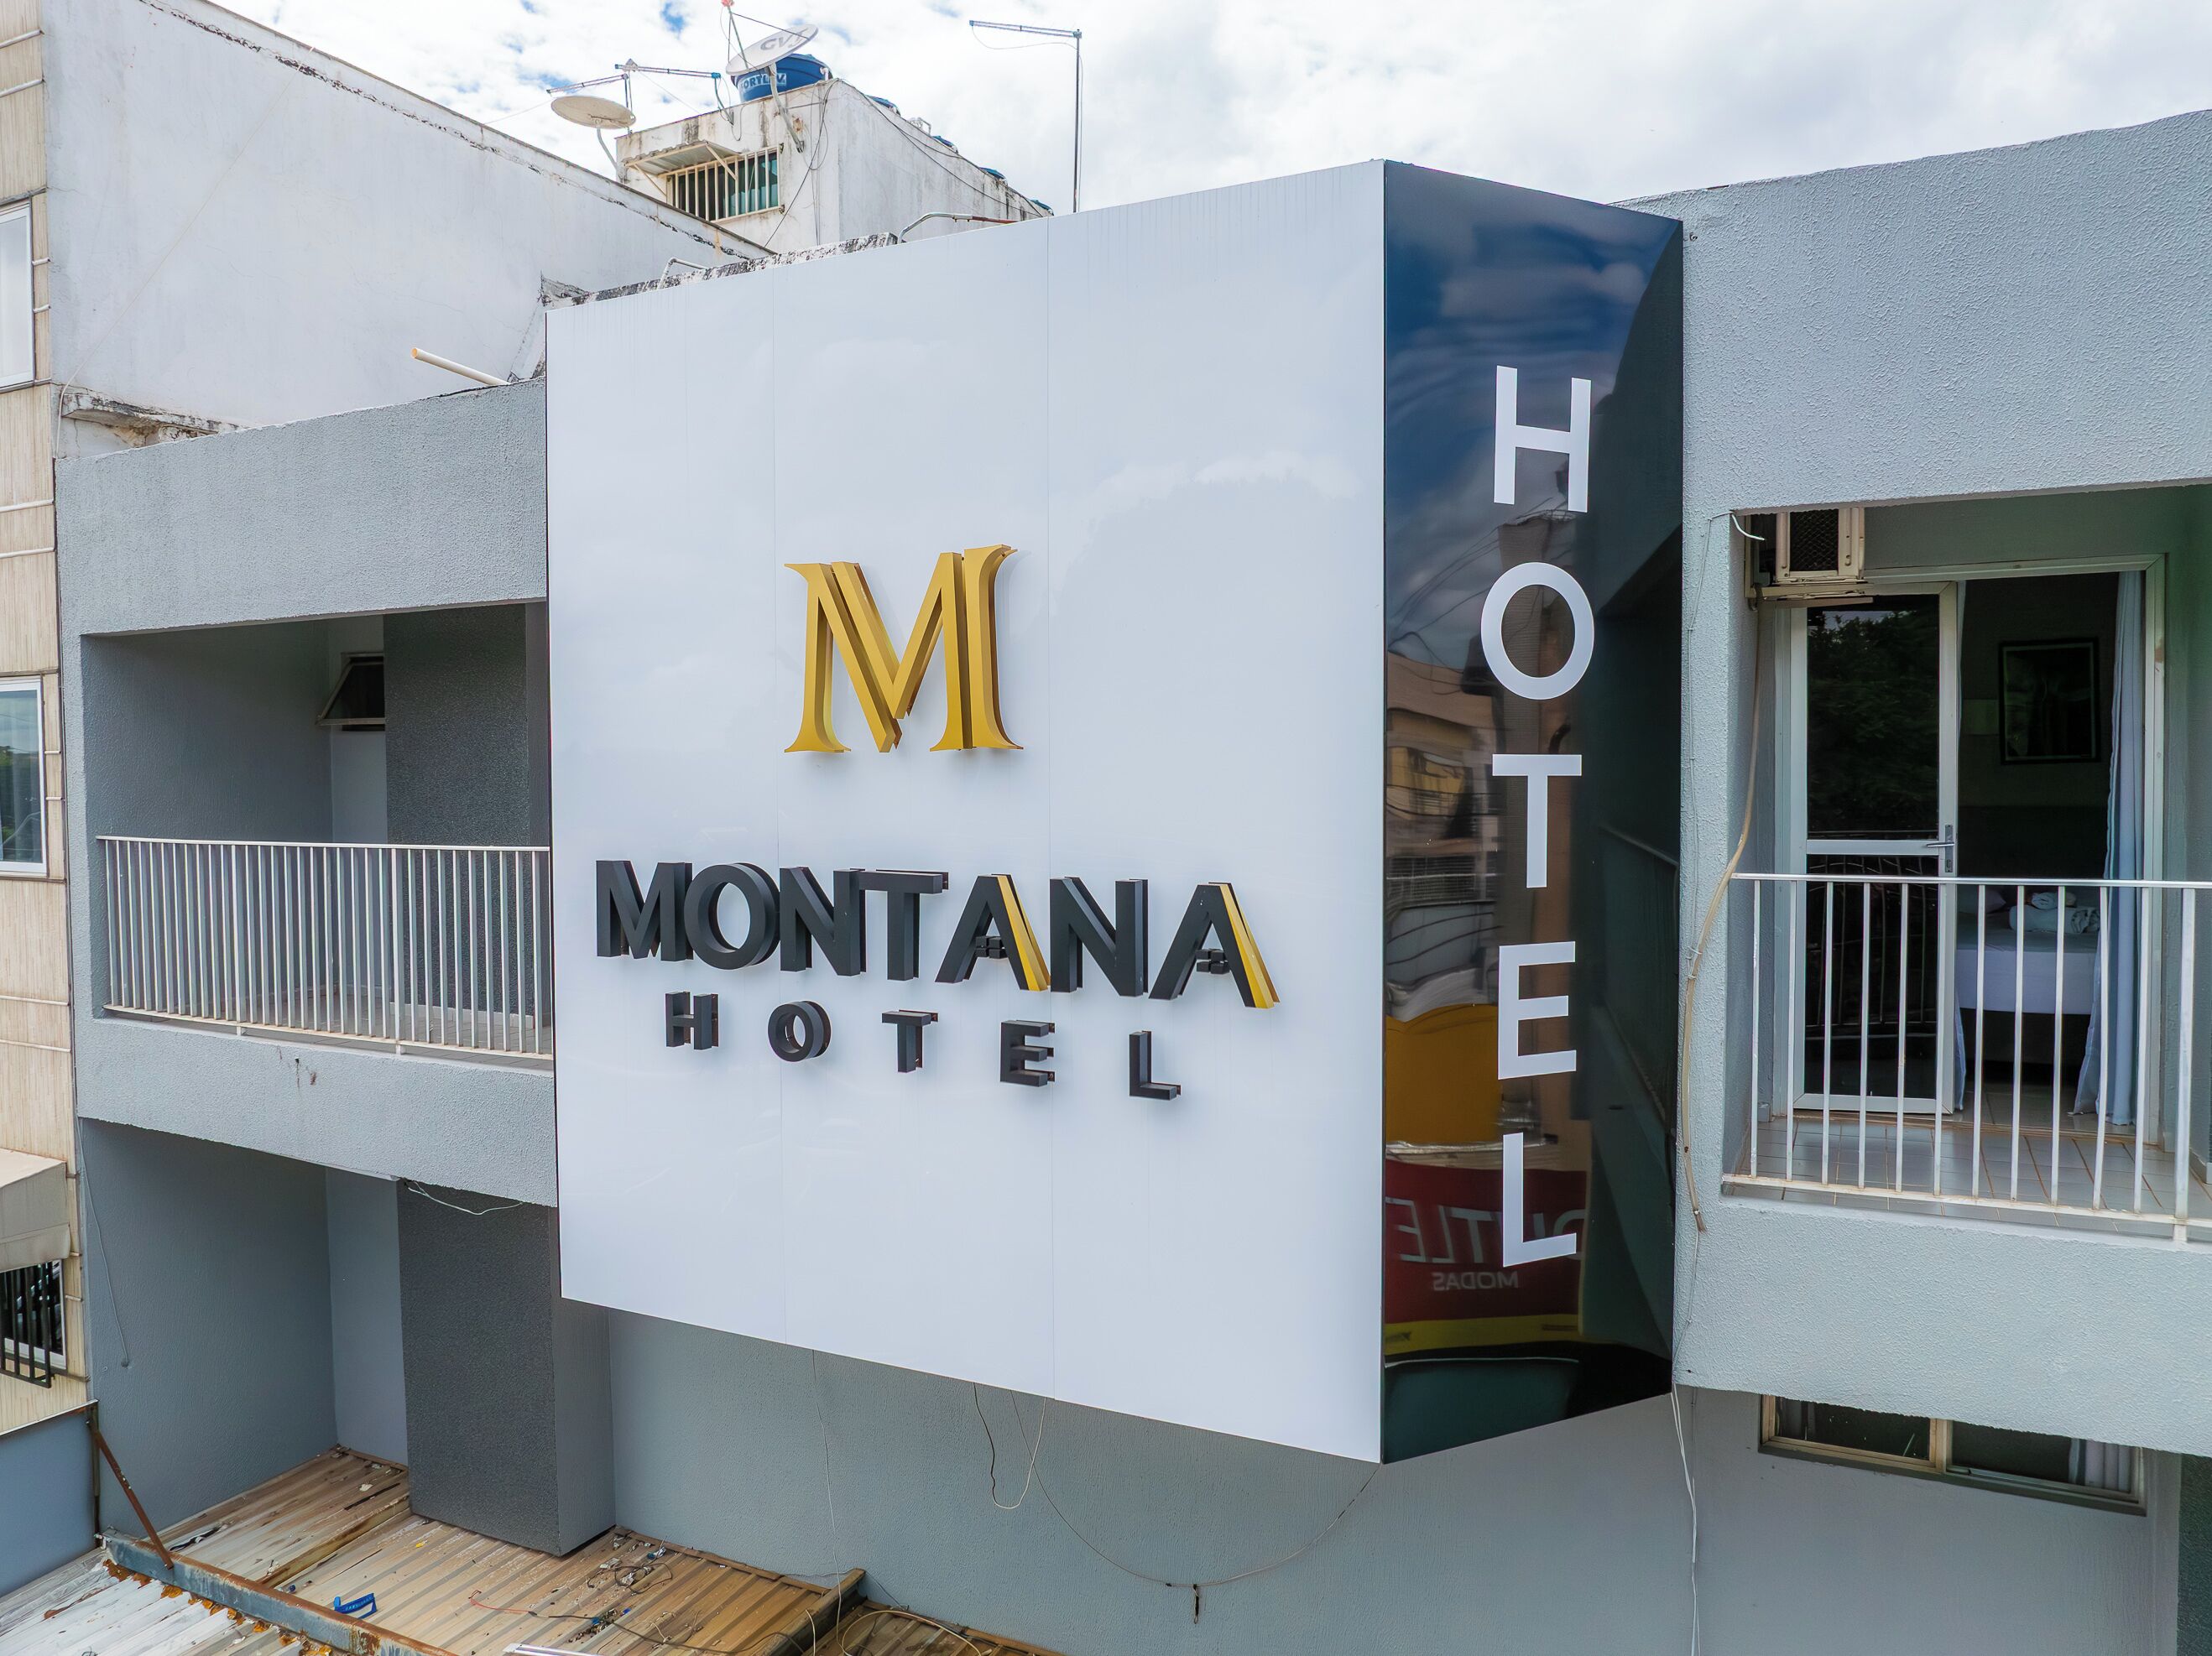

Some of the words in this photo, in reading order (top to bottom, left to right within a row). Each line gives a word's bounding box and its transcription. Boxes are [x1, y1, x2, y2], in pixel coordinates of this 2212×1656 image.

[740, 74, 785, 89] ORTLV
[785, 544, 1023, 752] M
[1480, 366, 1594, 1267] HOTEL
[595, 860, 1280, 1008] MONTANA
[665, 991, 1182, 1101] HOTEL
